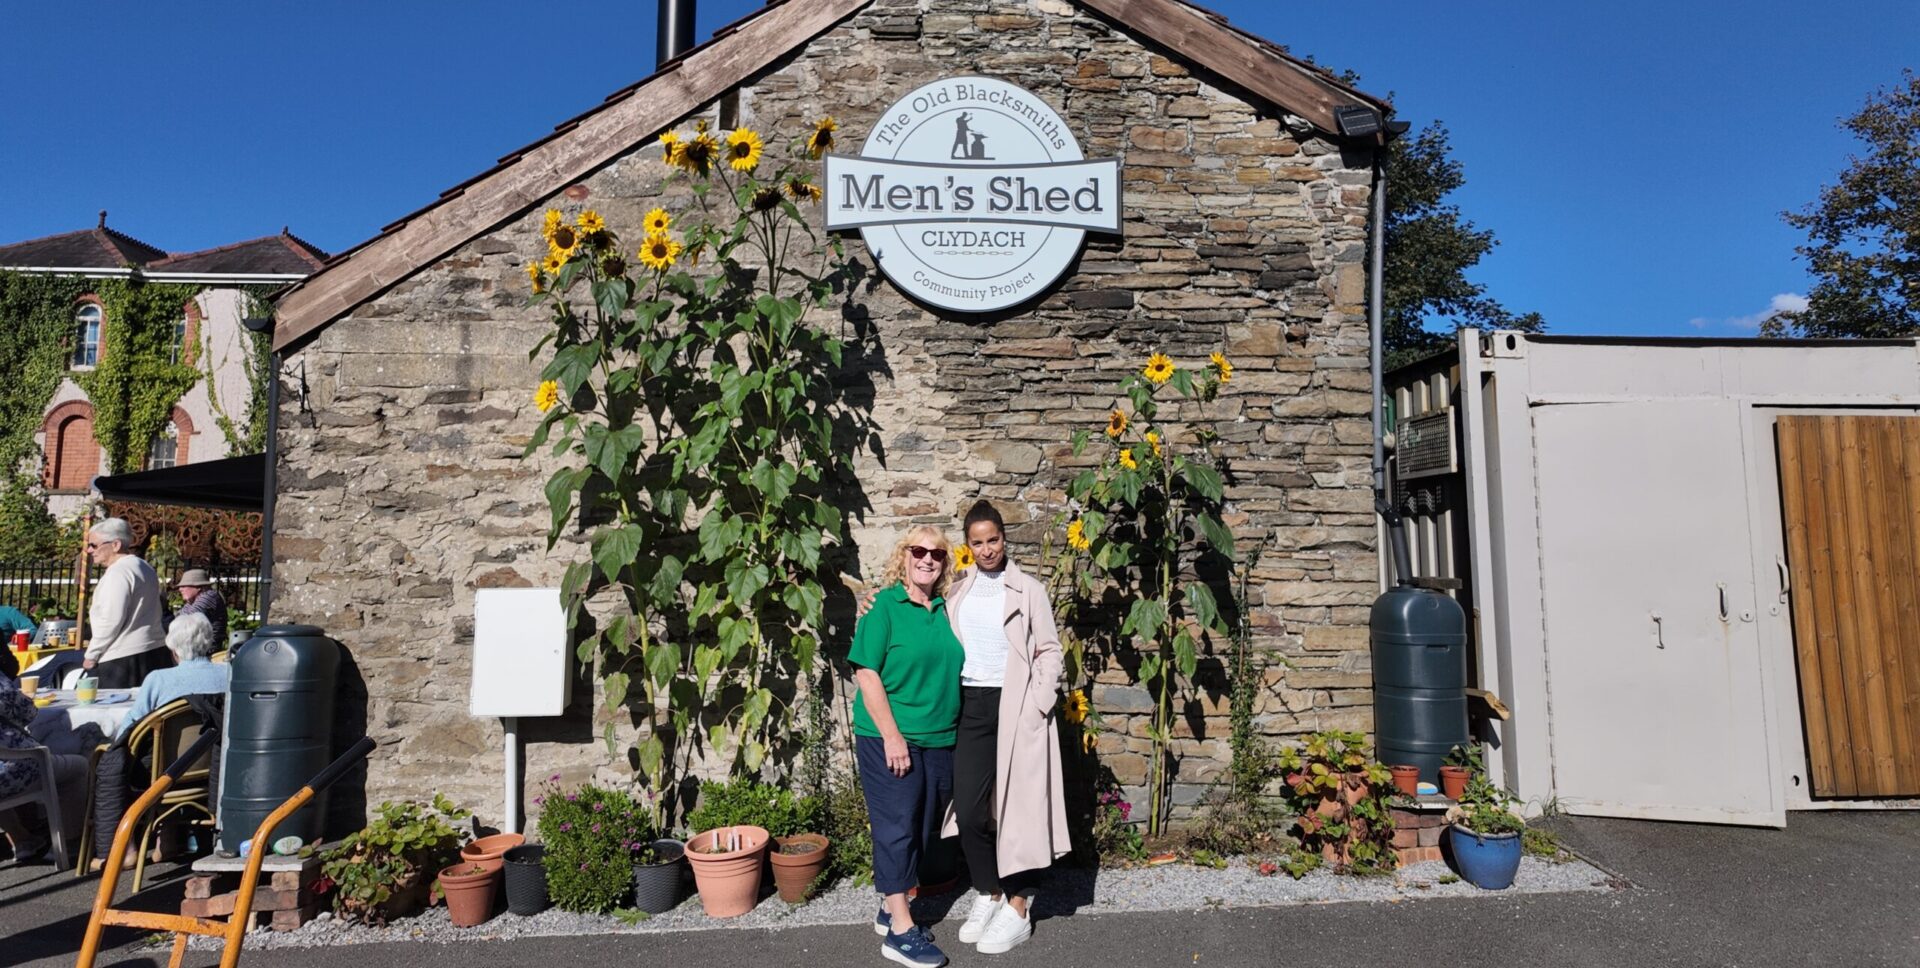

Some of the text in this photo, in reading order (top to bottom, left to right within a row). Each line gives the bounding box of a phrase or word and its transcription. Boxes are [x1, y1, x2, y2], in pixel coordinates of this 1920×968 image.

[876, 84, 1066, 151] The Old Blacksmiths
[839, 174, 1103, 214] Men's Shed
[921, 231, 1026, 248] CLYDACH
[913, 270, 1036, 301] Community Project
